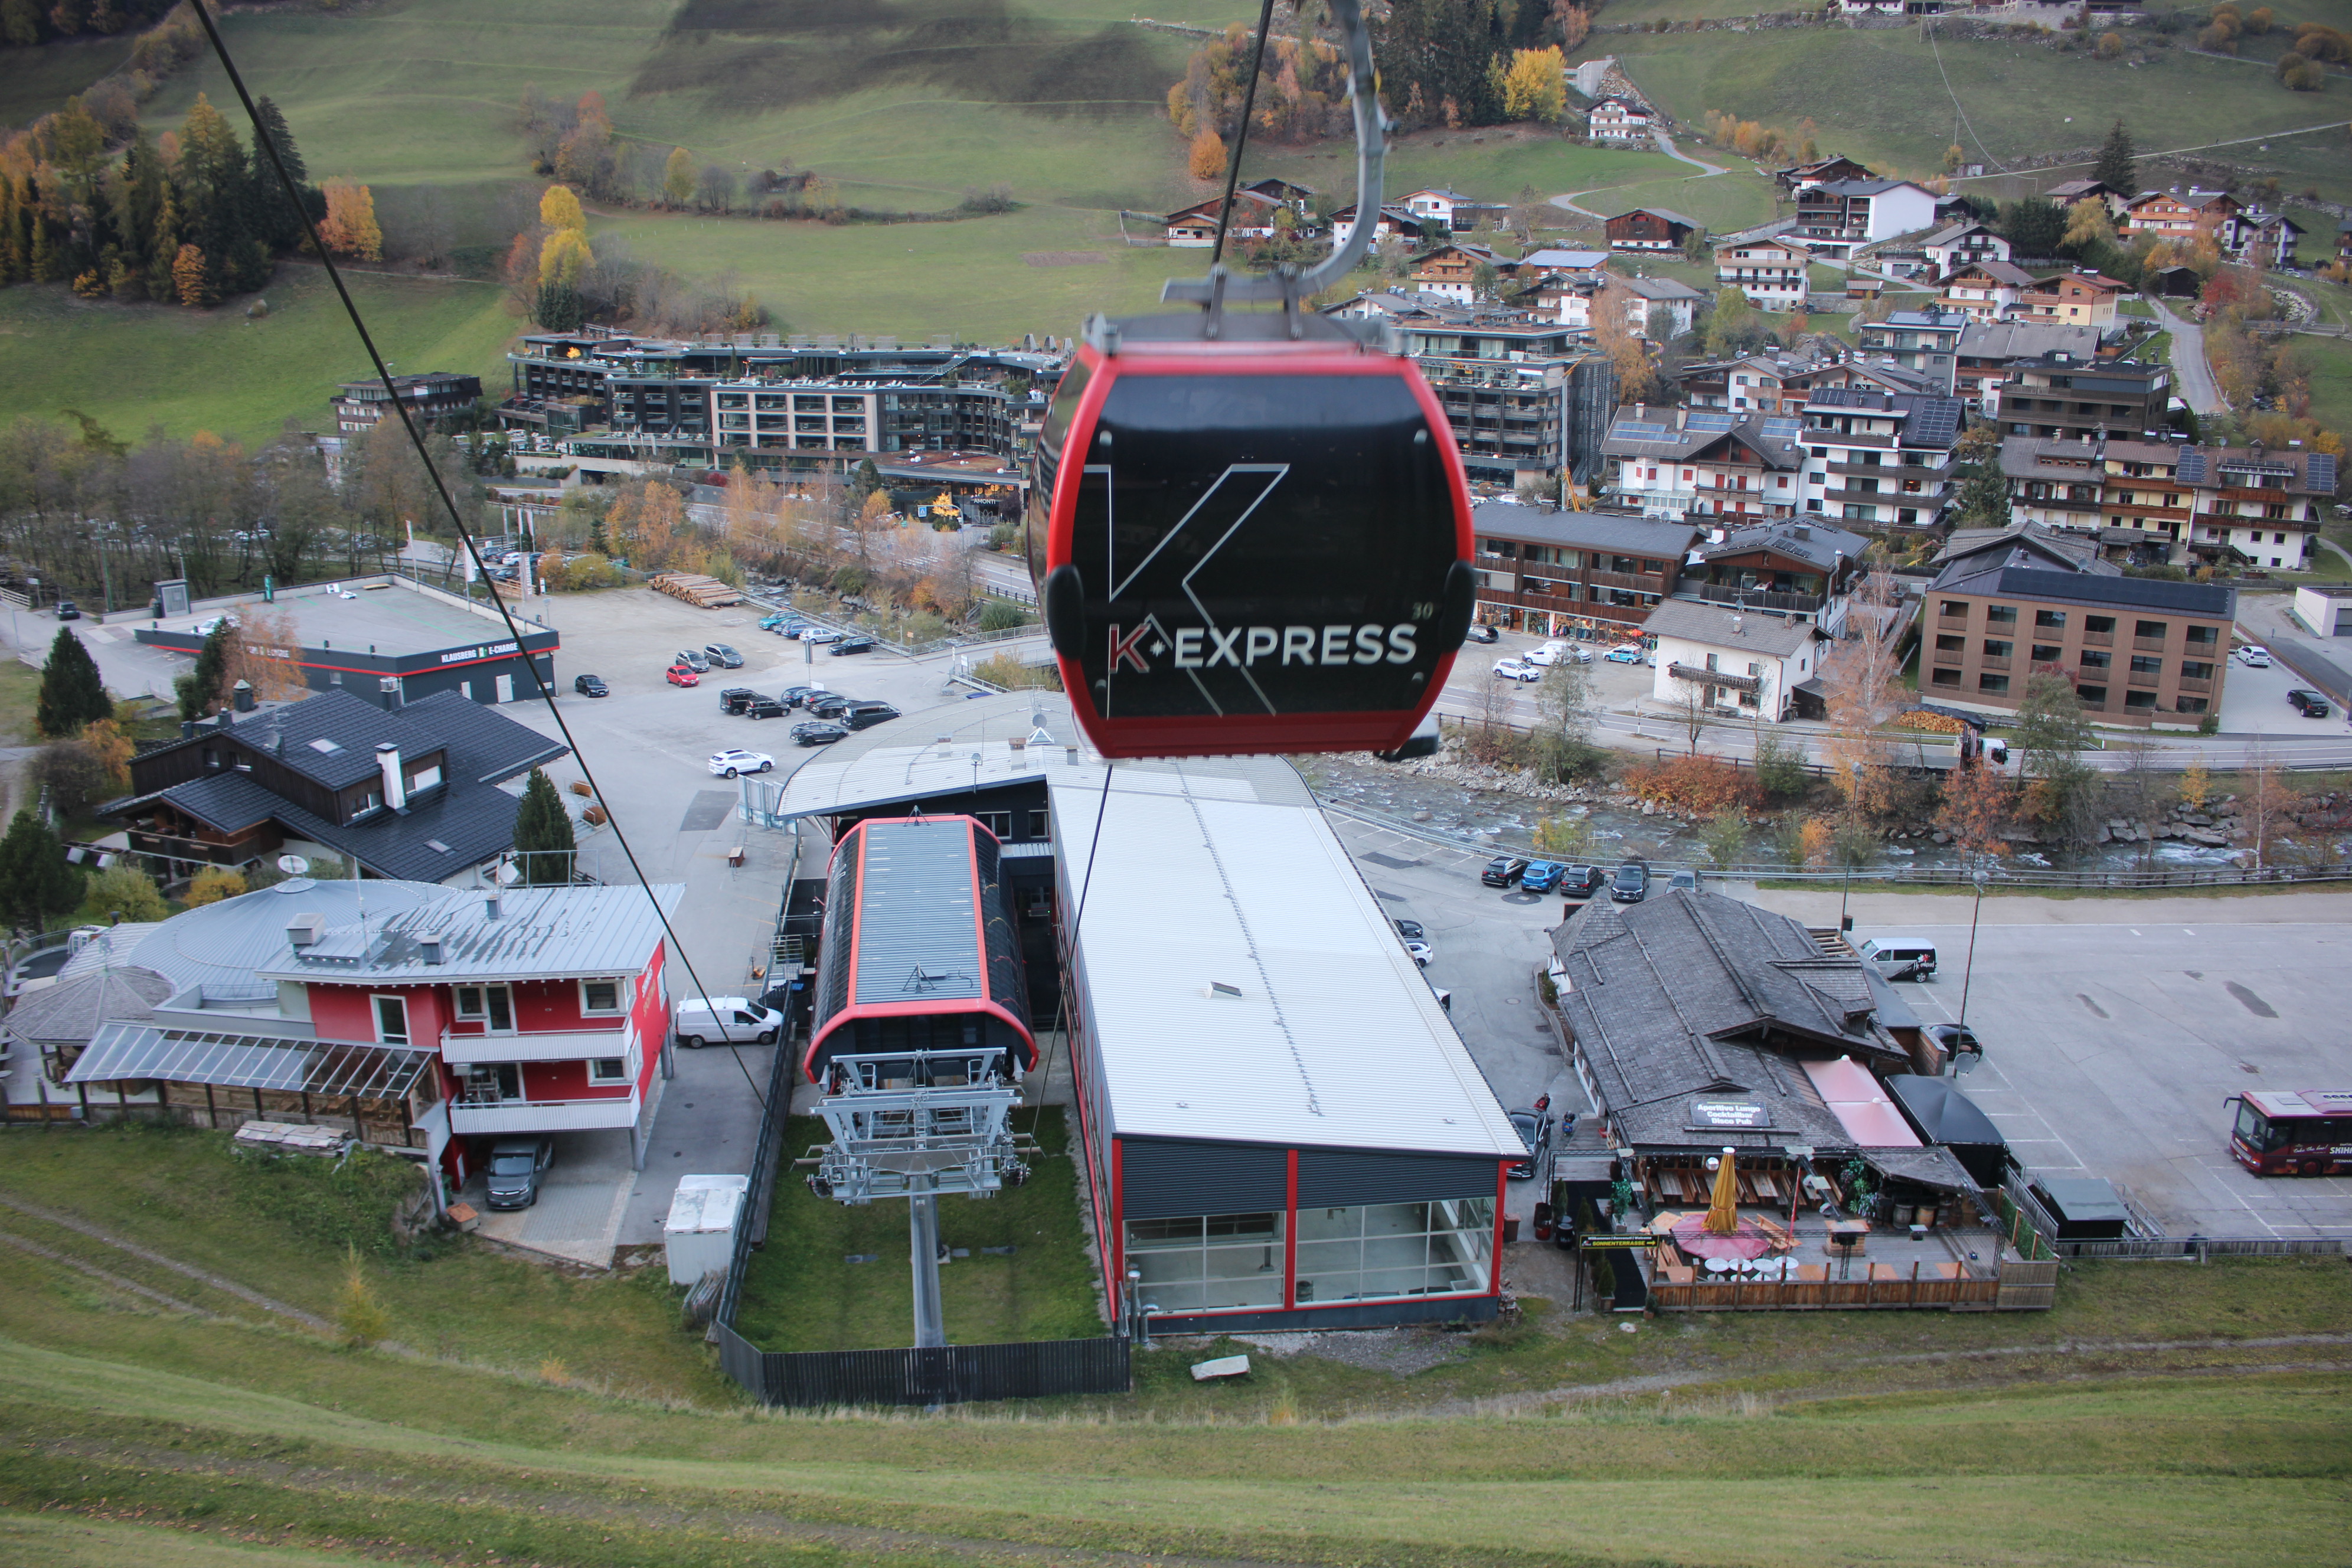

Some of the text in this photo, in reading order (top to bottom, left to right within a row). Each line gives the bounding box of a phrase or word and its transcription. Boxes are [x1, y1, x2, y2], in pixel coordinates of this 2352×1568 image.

[441, 642, 518, 663] KLAUSBERG E-CHARGE
[1109, 623, 1417, 674] K EXPRESS
